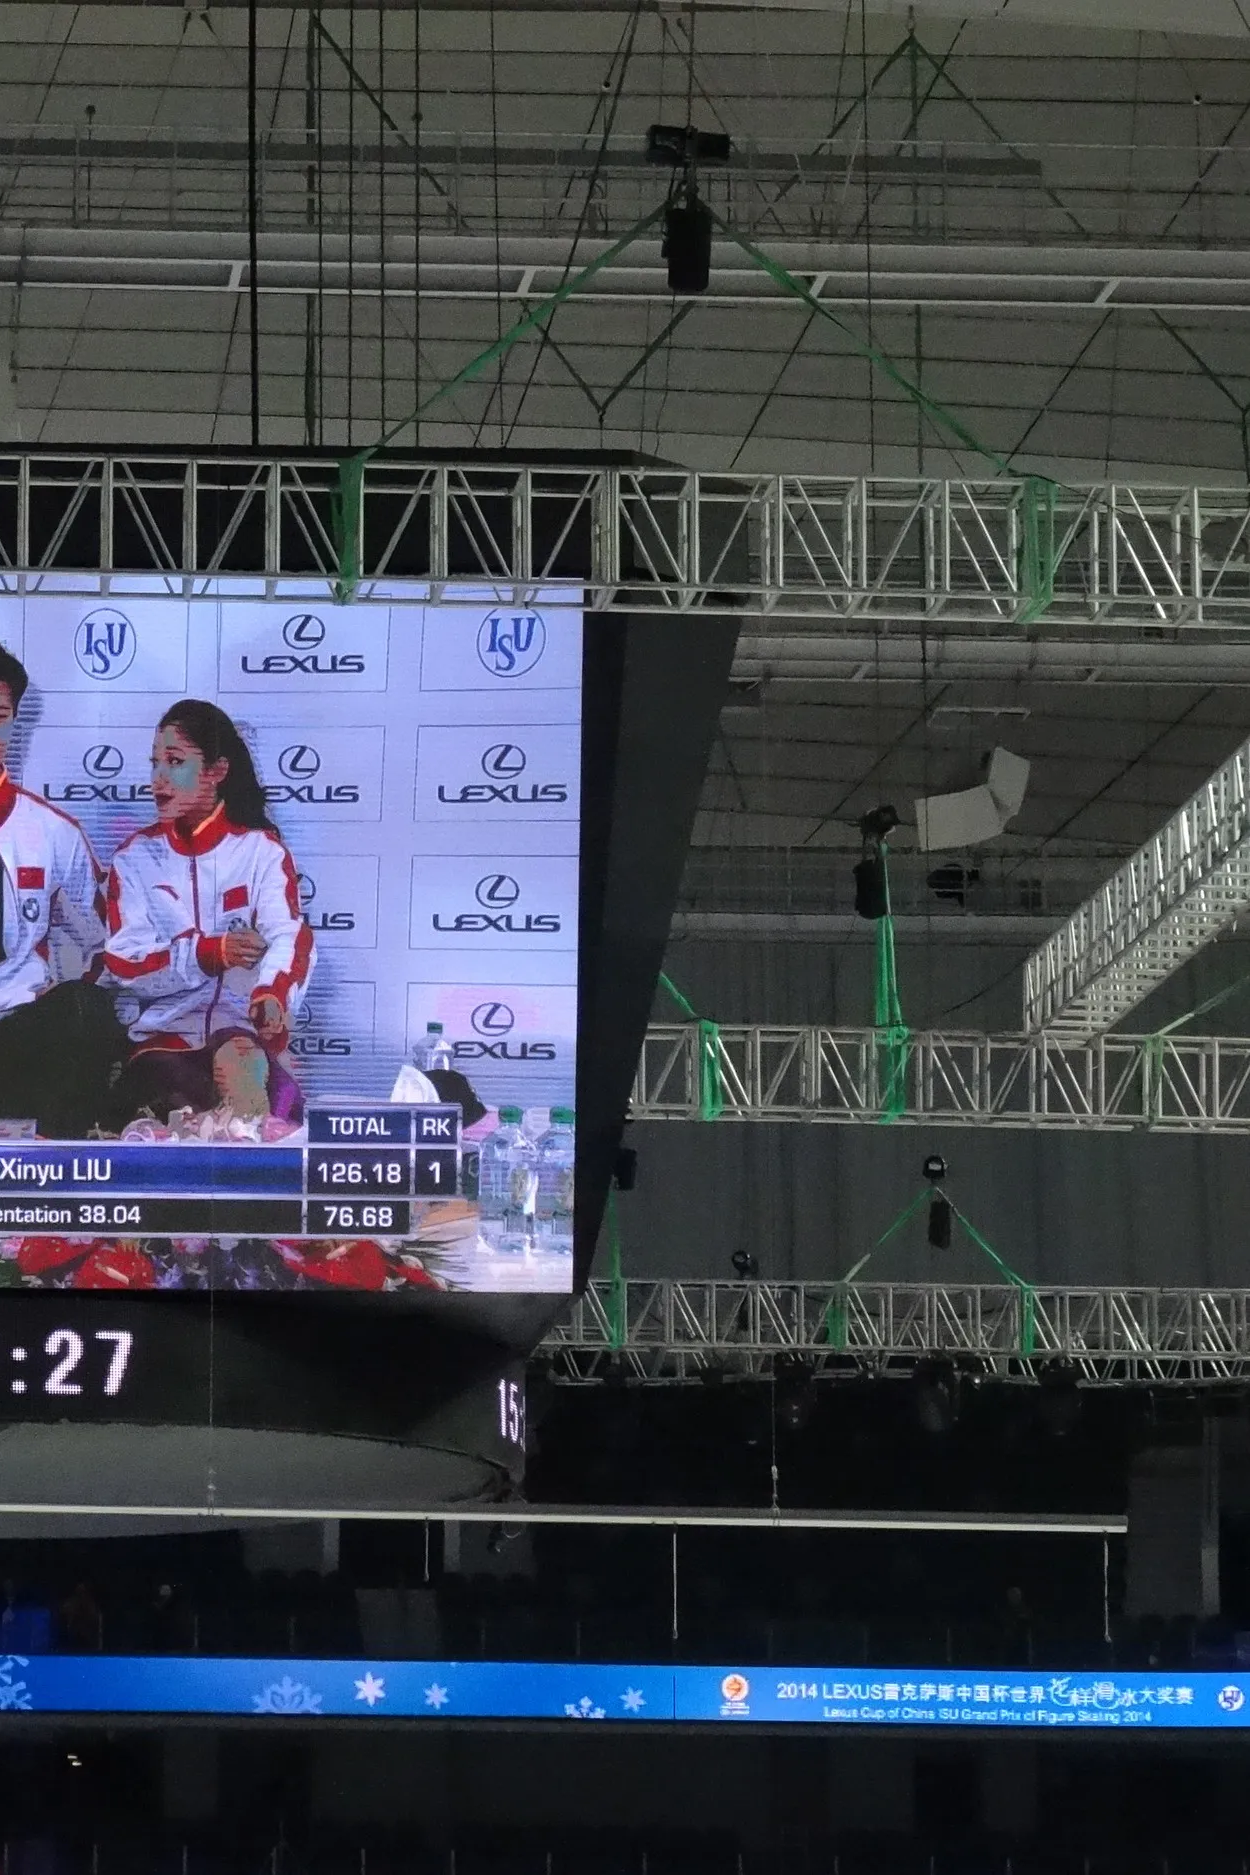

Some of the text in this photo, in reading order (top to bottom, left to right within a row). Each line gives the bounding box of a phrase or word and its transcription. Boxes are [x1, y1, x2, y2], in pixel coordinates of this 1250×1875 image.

[241, 654, 365, 674] LEXUS
[263, 785, 360, 804] EXUS
[437, 783, 568, 804] LEXUS
[432, 913, 561, 933] LEXUS
[453, 1041, 556, 1061] EXUS
[328, 1116, 391, 1136] TOTAL
[422, 1118, 451, 1136] RK
[0, 1157, 63, 1187] Xinyu
[72, 1158, 112, 1182] LIU
[317, 1162, 402, 1184] 126.18
[428, 1161, 441, 1184] 1
[79, 1205, 141, 1225] 38.04
[324, 1206, 393, 1228] 76.68
[777, 1683, 818, 1699] 2014
